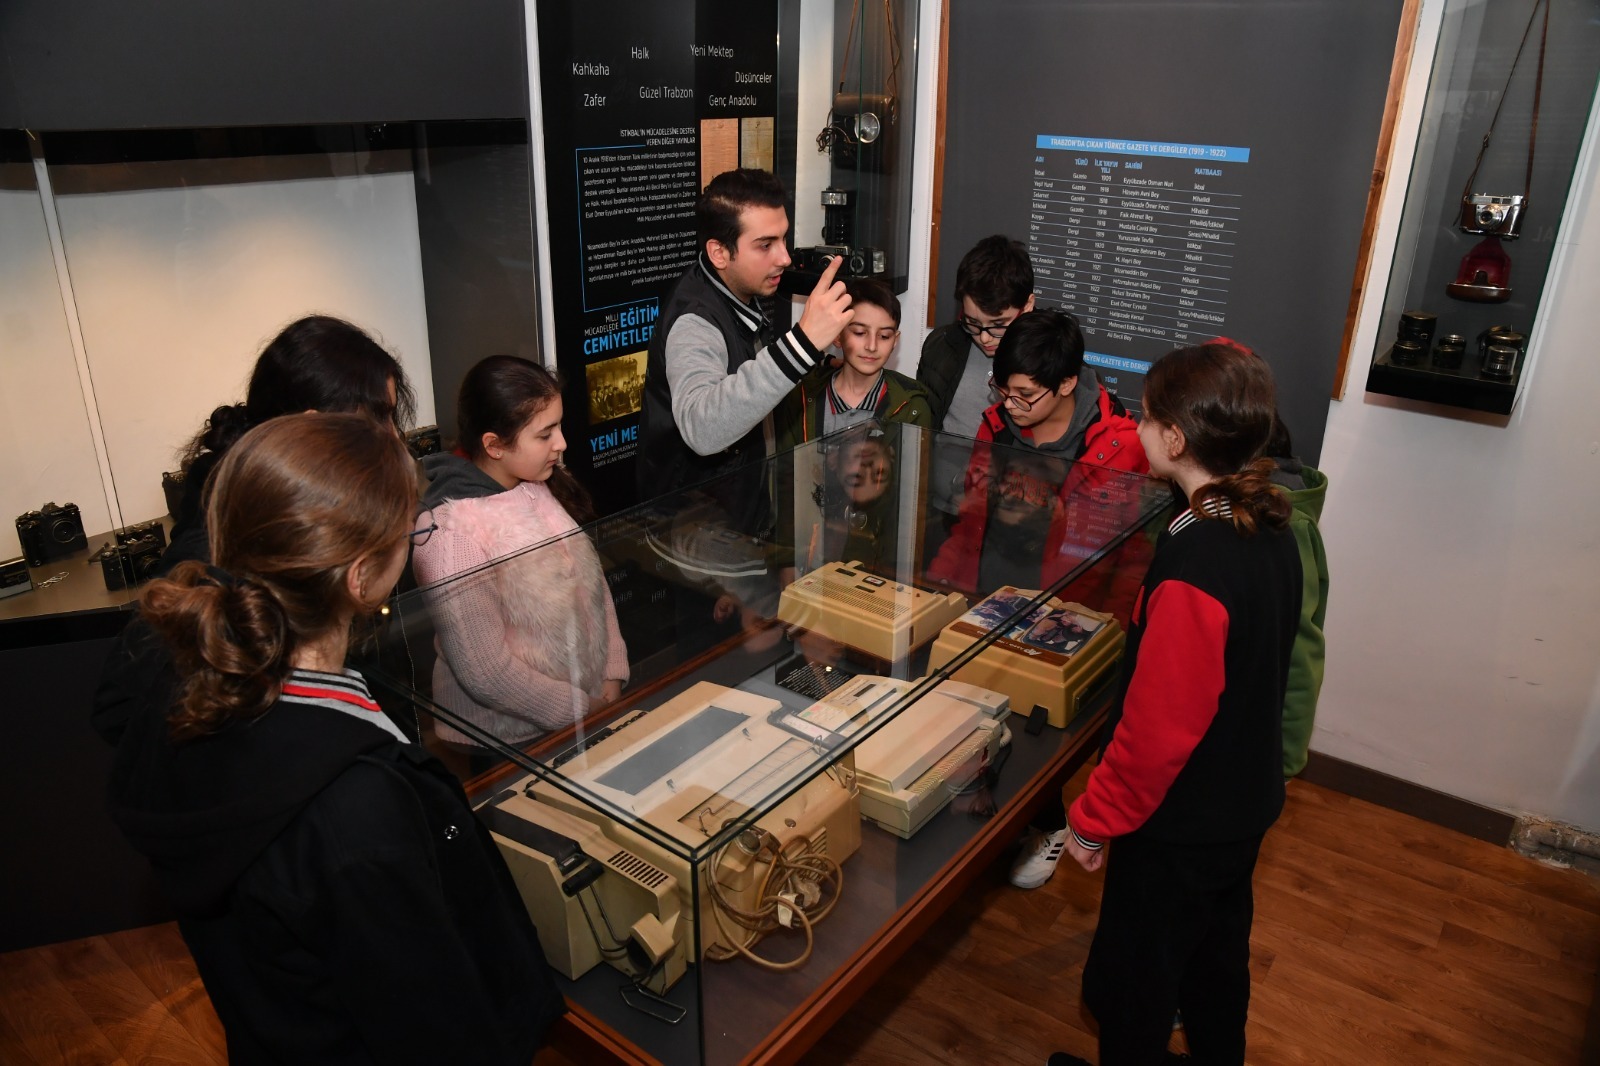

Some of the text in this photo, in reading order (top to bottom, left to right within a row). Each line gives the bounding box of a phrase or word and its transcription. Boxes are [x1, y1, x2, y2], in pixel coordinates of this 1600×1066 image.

[631, 46, 650, 60] Halk
[690, 44, 734, 59] Yeni Mektep
[572, 62, 610, 76] Kahkaha
[735, 71, 772, 85] Düşünceler
[639, 86, 694, 99] Güzel Trabzon
[583, 93, 607, 107] Zafer
[709, 95, 757, 108] Genç Anadolu
[1104, 140, 1126, 150] TÜRKÇE
[1126, 143, 1149, 152] GAZETE
[1150, 144, 1158, 152] VE
[1158, 144, 1188, 154] DERGİLER
[620, 304, 659, 328] EĞİTİM
[584, 322, 619, 337] MÜCADELEDE
[1101, 356, 1122, 367] GAZETE
[1122, 359, 1130, 367] VE
[590, 428, 618, 453] YENİ
